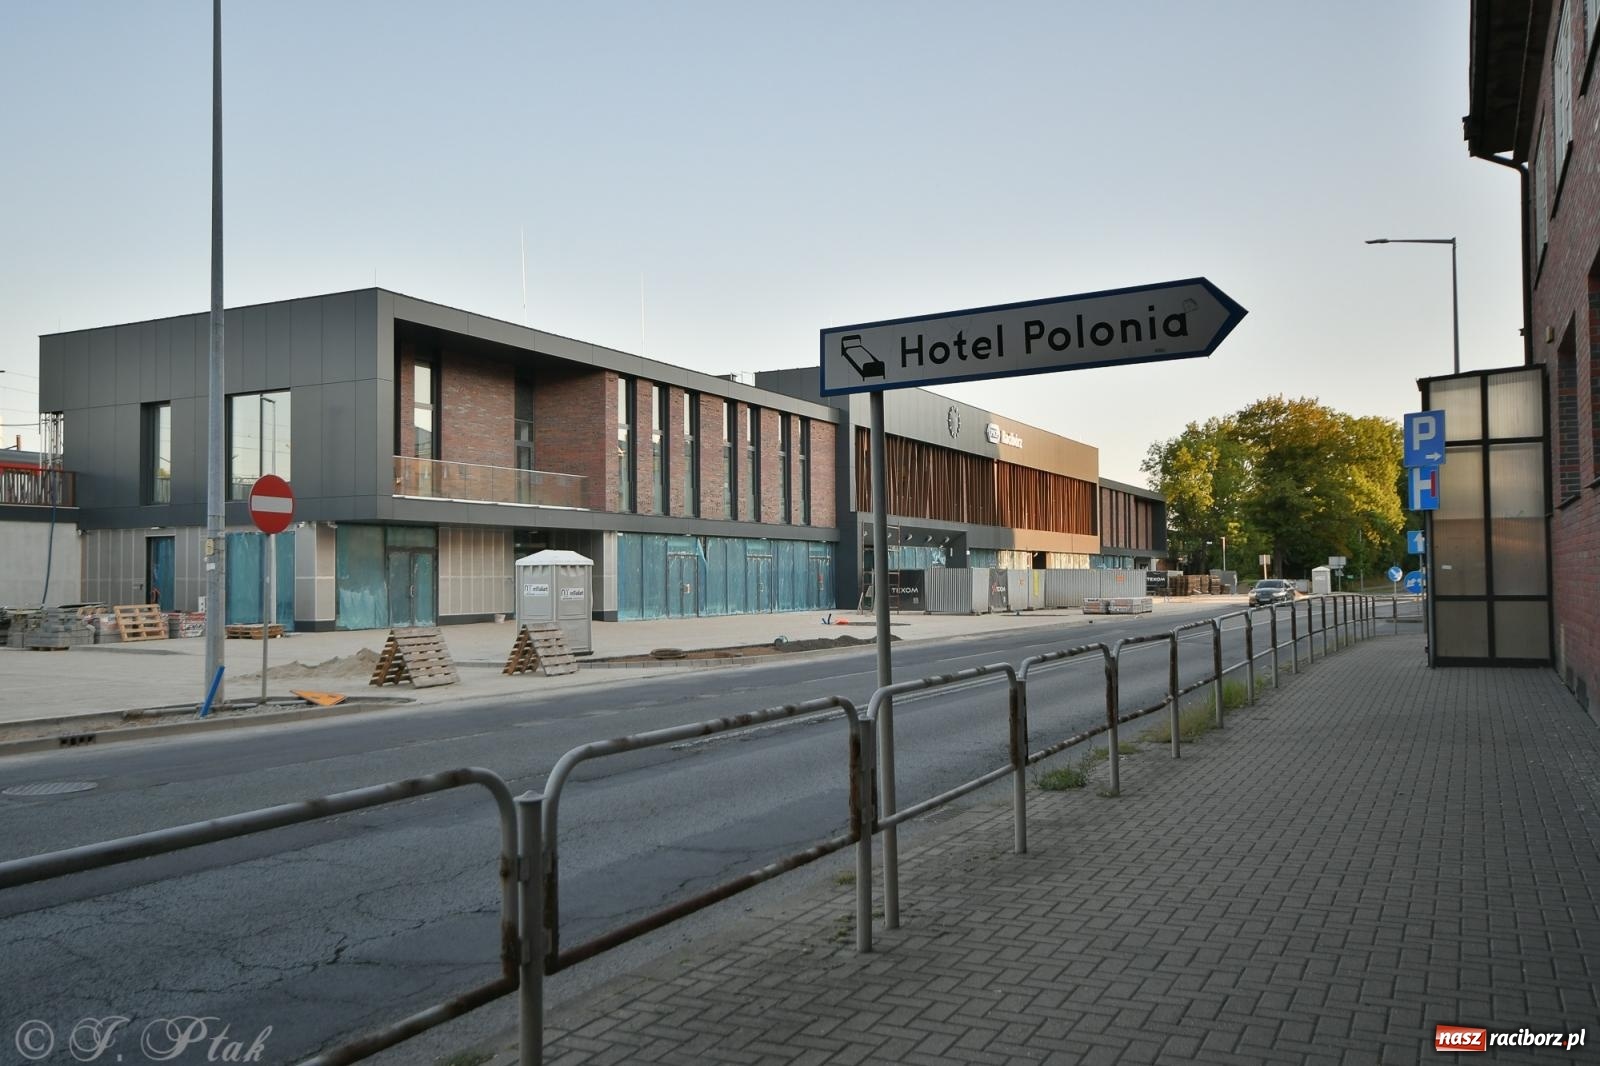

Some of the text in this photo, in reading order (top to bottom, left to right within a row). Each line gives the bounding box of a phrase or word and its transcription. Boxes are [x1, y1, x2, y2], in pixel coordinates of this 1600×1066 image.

[900, 304, 1189, 368] Hotel Polonia
[1413, 416, 1435, 450] P
